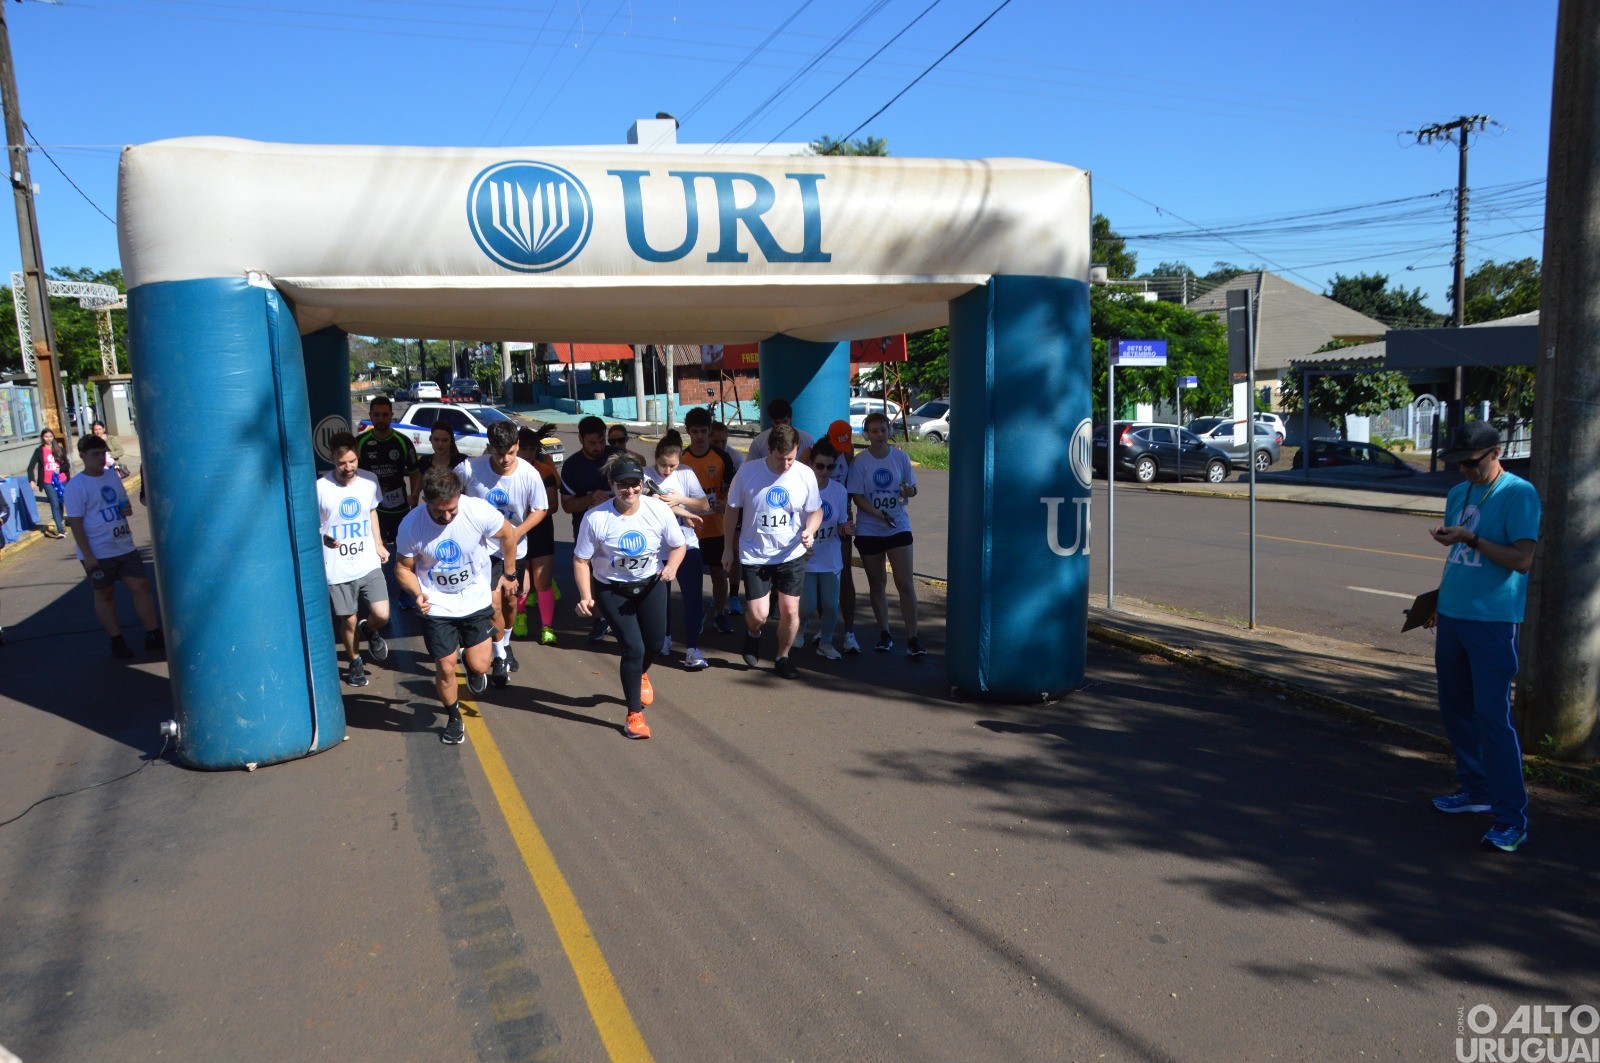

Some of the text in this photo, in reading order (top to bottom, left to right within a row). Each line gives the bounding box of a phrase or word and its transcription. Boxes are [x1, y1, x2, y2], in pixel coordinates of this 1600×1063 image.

[606, 169, 832, 263] URI
[873, 497, 897, 509] 049
[761, 514, 787, 528] 114
[339, 541, 364, 556] 064
[619, 556, 650, 569] 127
[436, 570, 469, 586] 068
